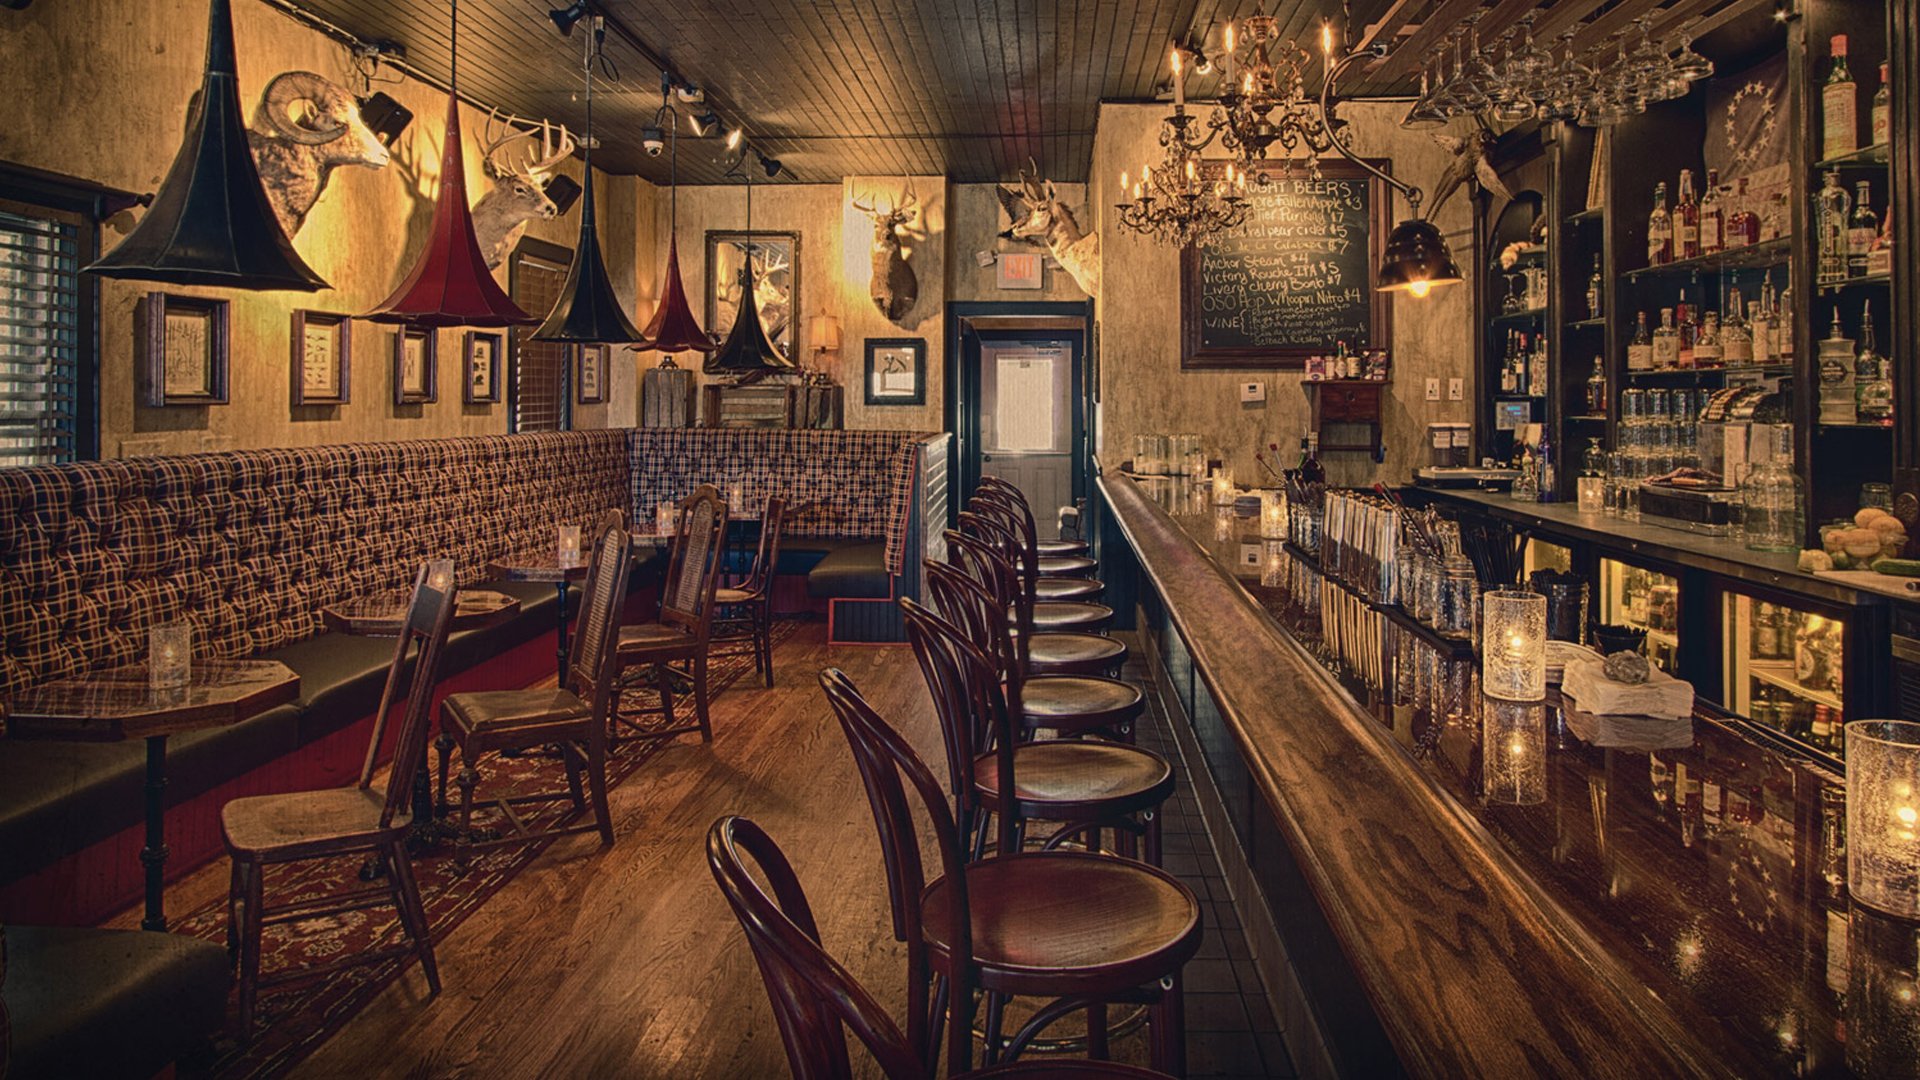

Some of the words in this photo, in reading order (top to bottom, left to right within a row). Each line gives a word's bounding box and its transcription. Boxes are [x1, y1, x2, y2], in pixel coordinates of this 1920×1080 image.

[1293, 181, 1351, 198] BEERS
[1345, 196, 1362, 210] $3
[1267, 226, 1293, 240] pear
[1329, 223, 1348, 238] $5
[1327, 238, 1350, 254] $7
[1005, 255, 1034, 278] EXIT
[1203, 255, 1240, 271] Anchor
[1243, 255, 1286, 268] Steam
[1289, 253, 1308, 264] $4
[1203, 272, 1248, 285] Victory
[1293, 263, 1317, 277] IPA
[1319, 260, 1339, 274] $5
[1203, 284, 1245, 297] Livery
[1289, 276, 1325, 290] Bomb
[1327, 274, 1342, 286] $7
[1202, 295, 1237, 312] OSO
[1239, 294, 1265, 309] Hop
[1316, 290, 1344, 305] Nitro
[1343, 288, 1361, 303] $4
[1205, 316, 1240, 329] WINE
